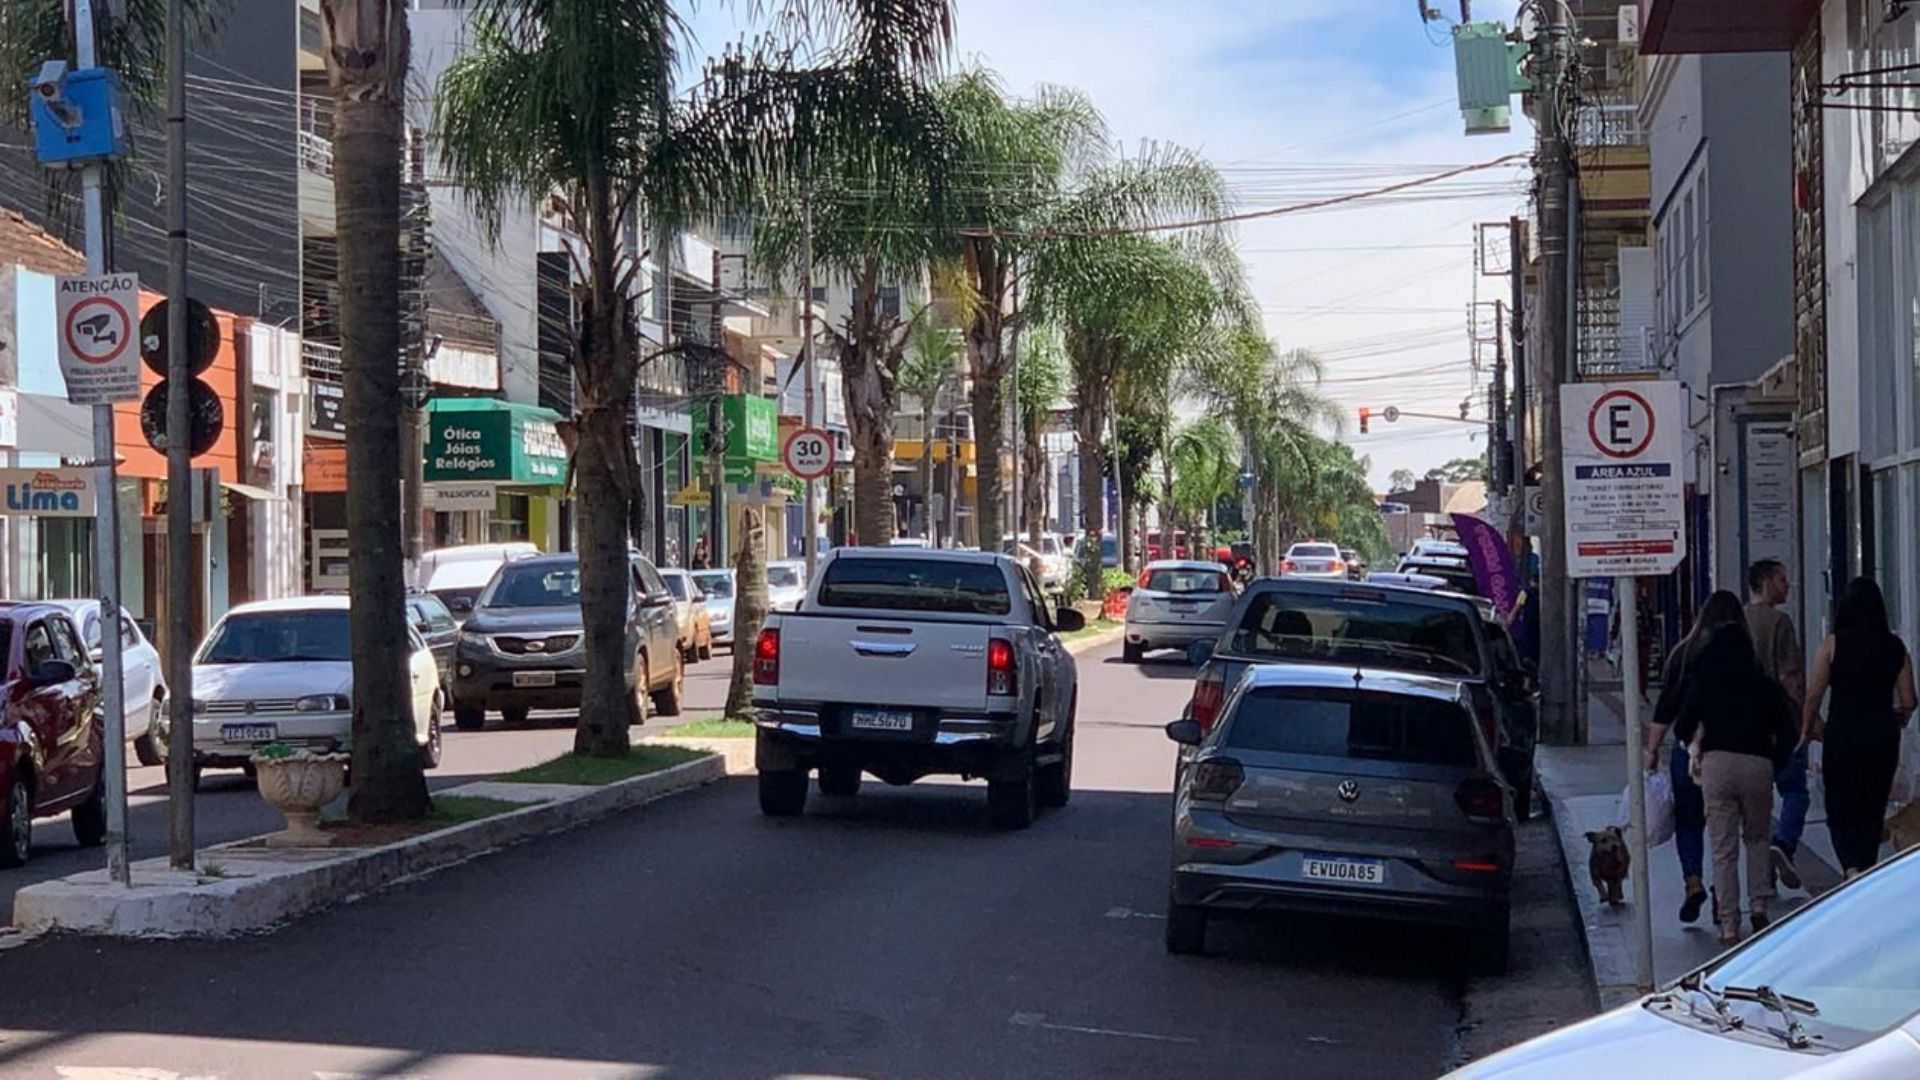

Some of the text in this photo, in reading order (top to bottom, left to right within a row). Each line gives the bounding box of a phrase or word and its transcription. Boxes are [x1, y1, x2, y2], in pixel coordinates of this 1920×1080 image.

[61, 277, 133, 294] ATENÇÃO
[443, 425, 481, 440] Ótica
[1609, 405, 1632, 444] E
[444, 442, 481, 455] Jóias
[797, 440, 822, 457] 30
[435, 457, 496, 472] Relógios
[1626, 466, 1656, 478] AZUL
[7, 482, 79, 511] Lima
